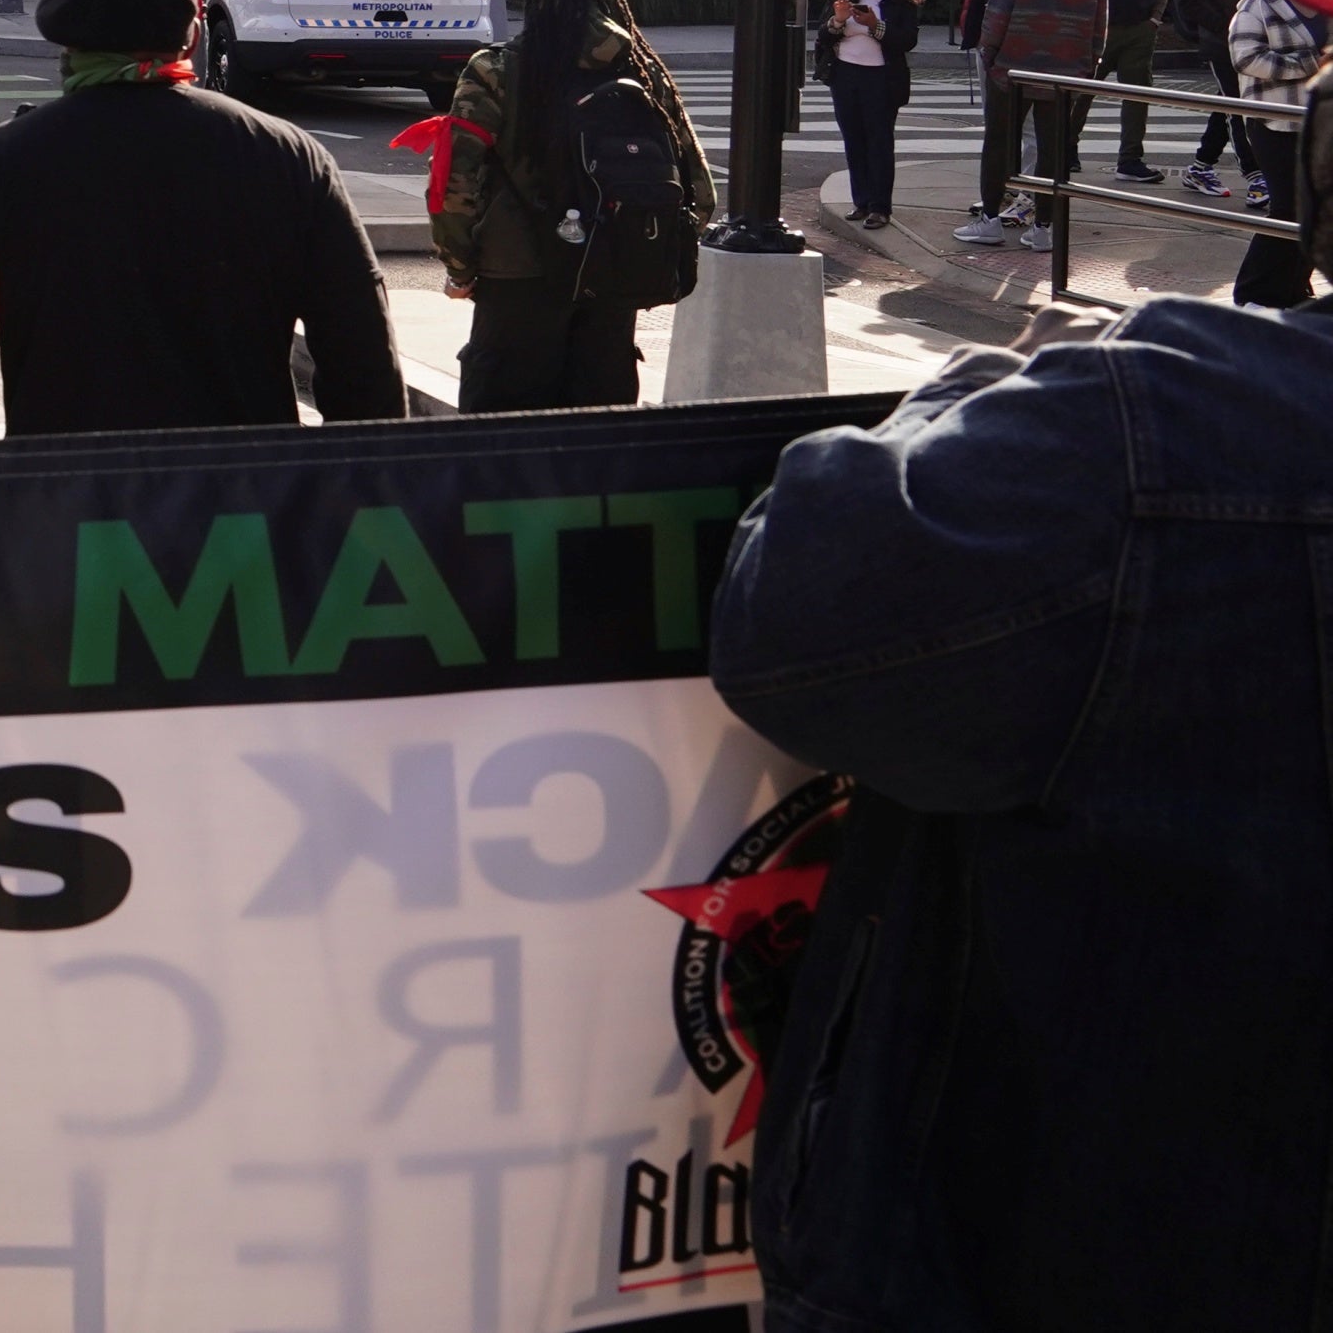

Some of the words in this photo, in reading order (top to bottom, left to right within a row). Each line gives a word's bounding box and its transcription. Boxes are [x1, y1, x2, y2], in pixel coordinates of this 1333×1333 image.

[352, 3, 433, 11] METROPOLITAN
[374, 30, 413, 39] POLICE
[68, 485, 745, 688] MATT
[730, 790, 821, 875] SOCIAL
[696, 874, 736, 934] FOR
[683, 934, 727, 1074] COALITION
